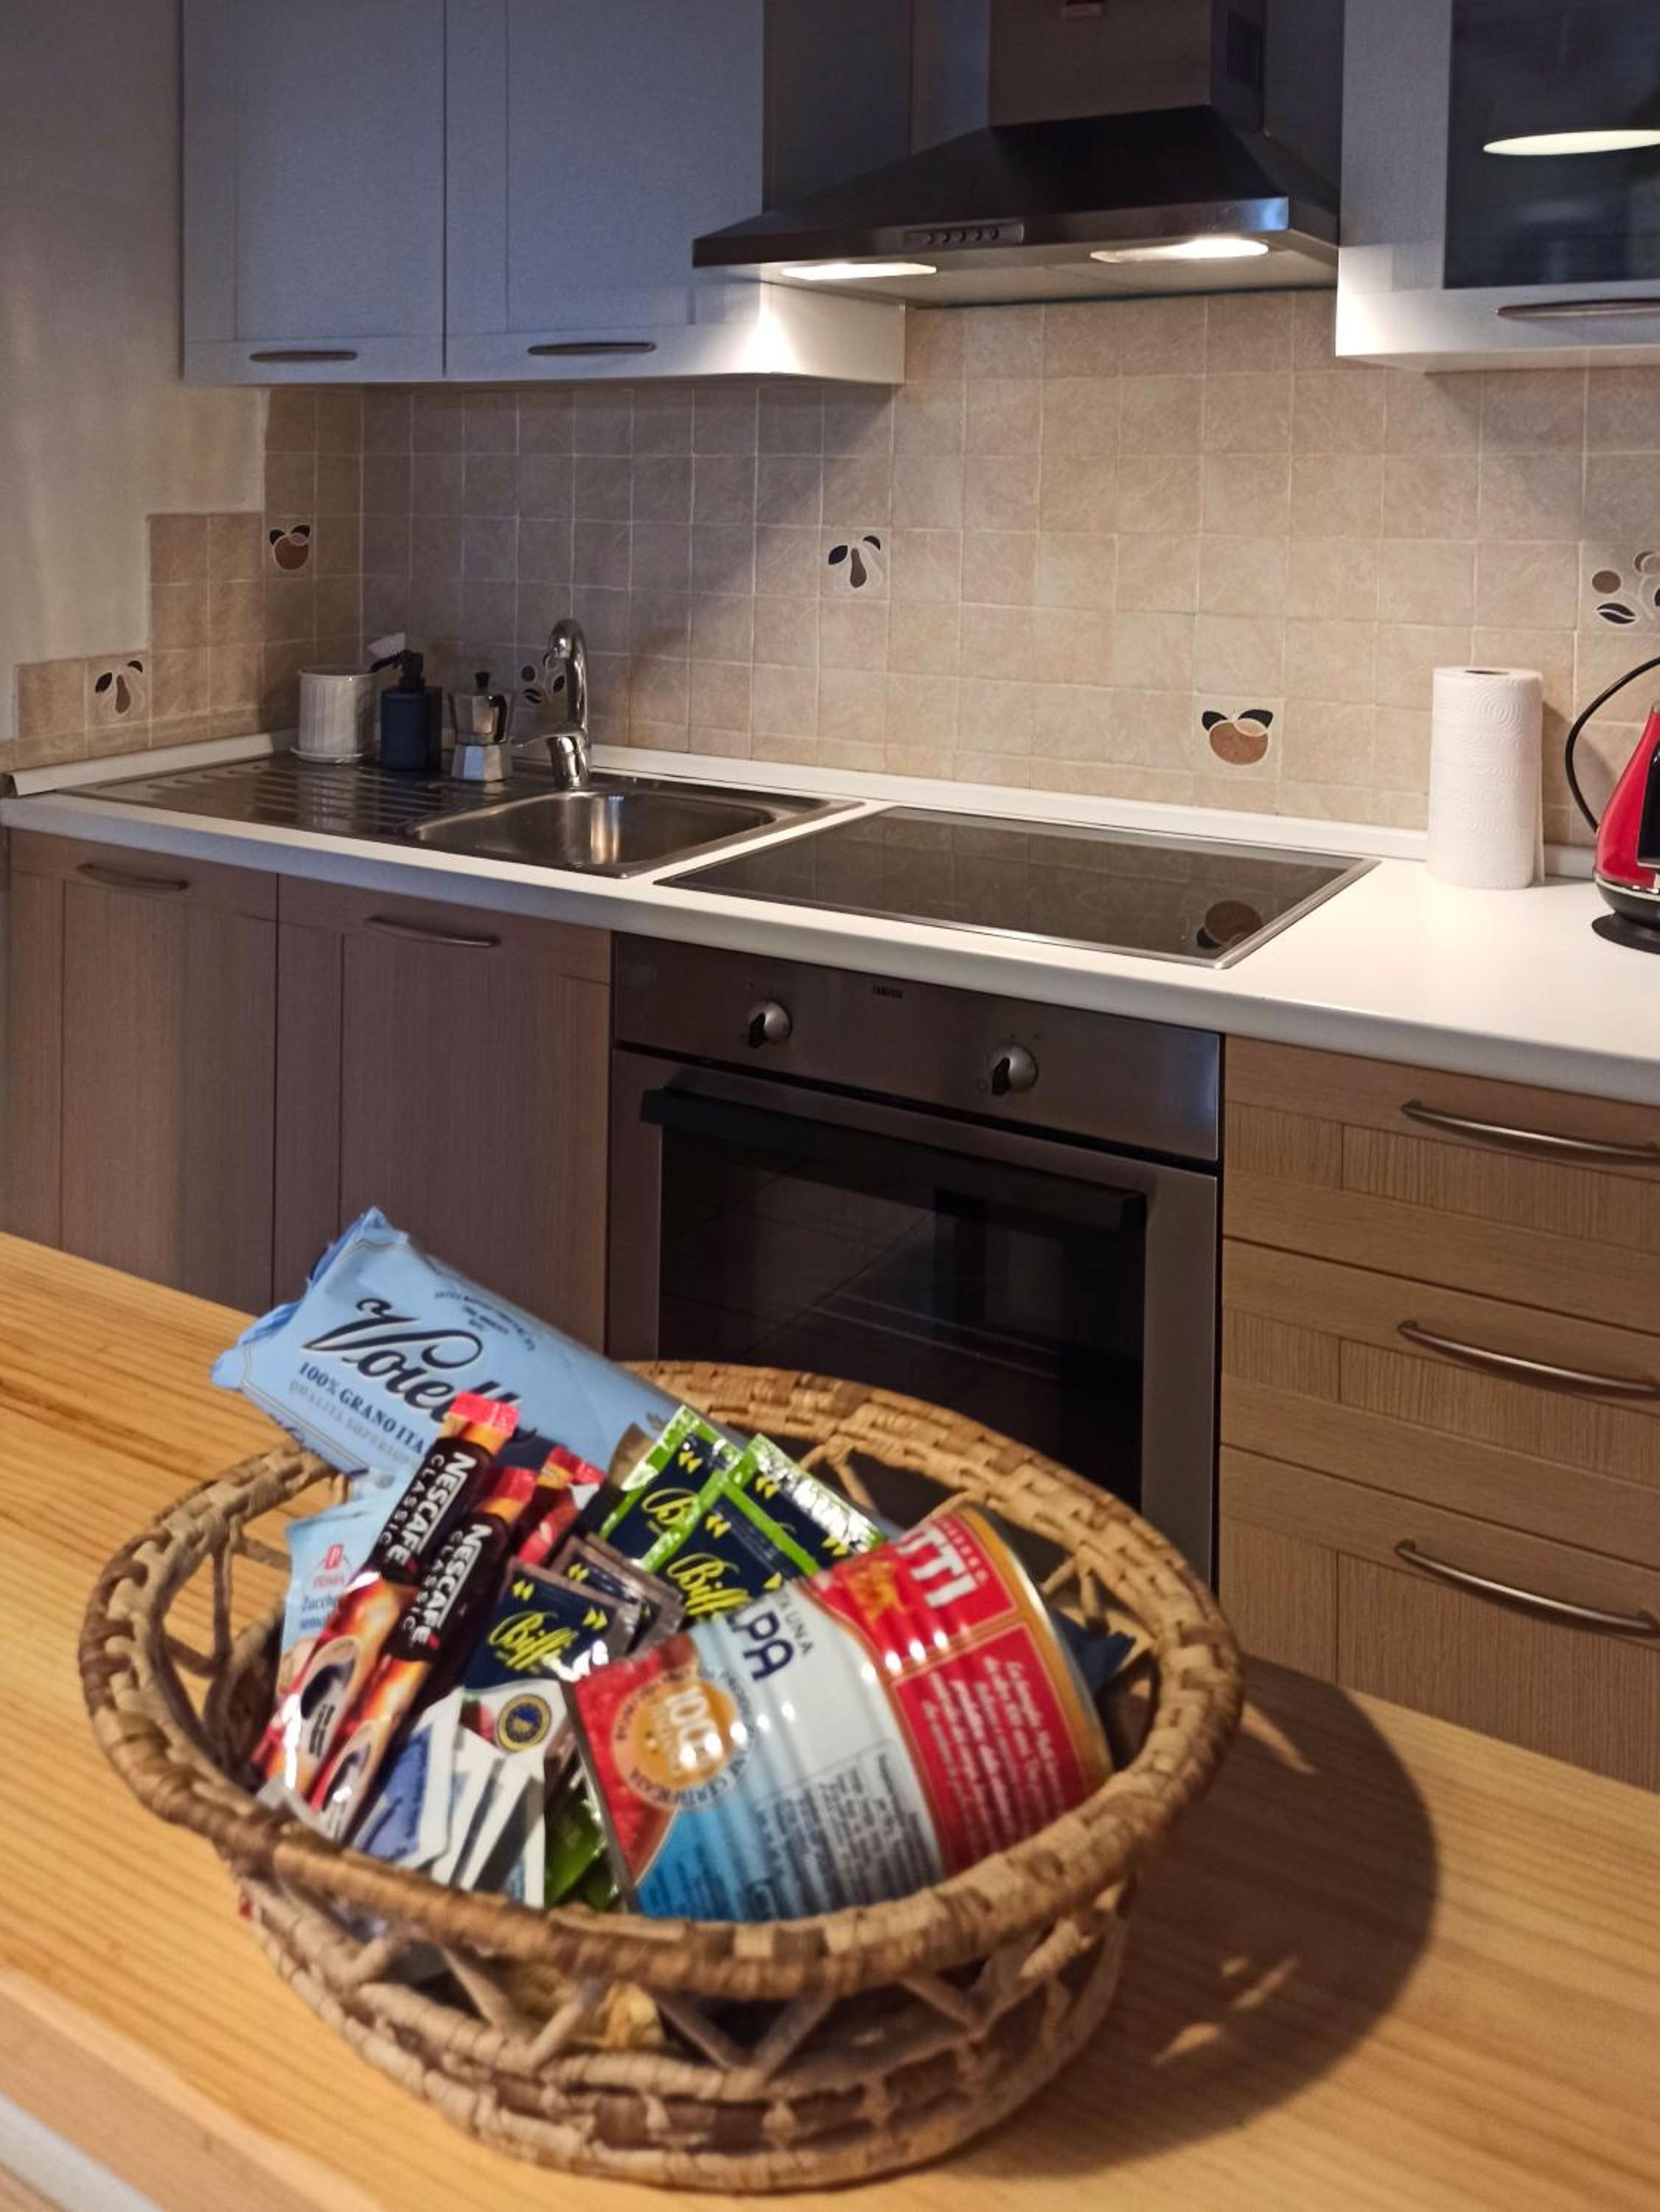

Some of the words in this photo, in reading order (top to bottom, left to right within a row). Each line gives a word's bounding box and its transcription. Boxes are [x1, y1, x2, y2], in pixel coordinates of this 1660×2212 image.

[299, 1361, 337, 1396] 100%
[339, 1388, 397, 1433] GRANO
[396, 1427, 425, 1455] ITA
[303, 1297, 522, 1424] Voiel
[378, 1453, 445, 1545] CLASSIC
[403, 1529, 464, 1630] CLASSIC
